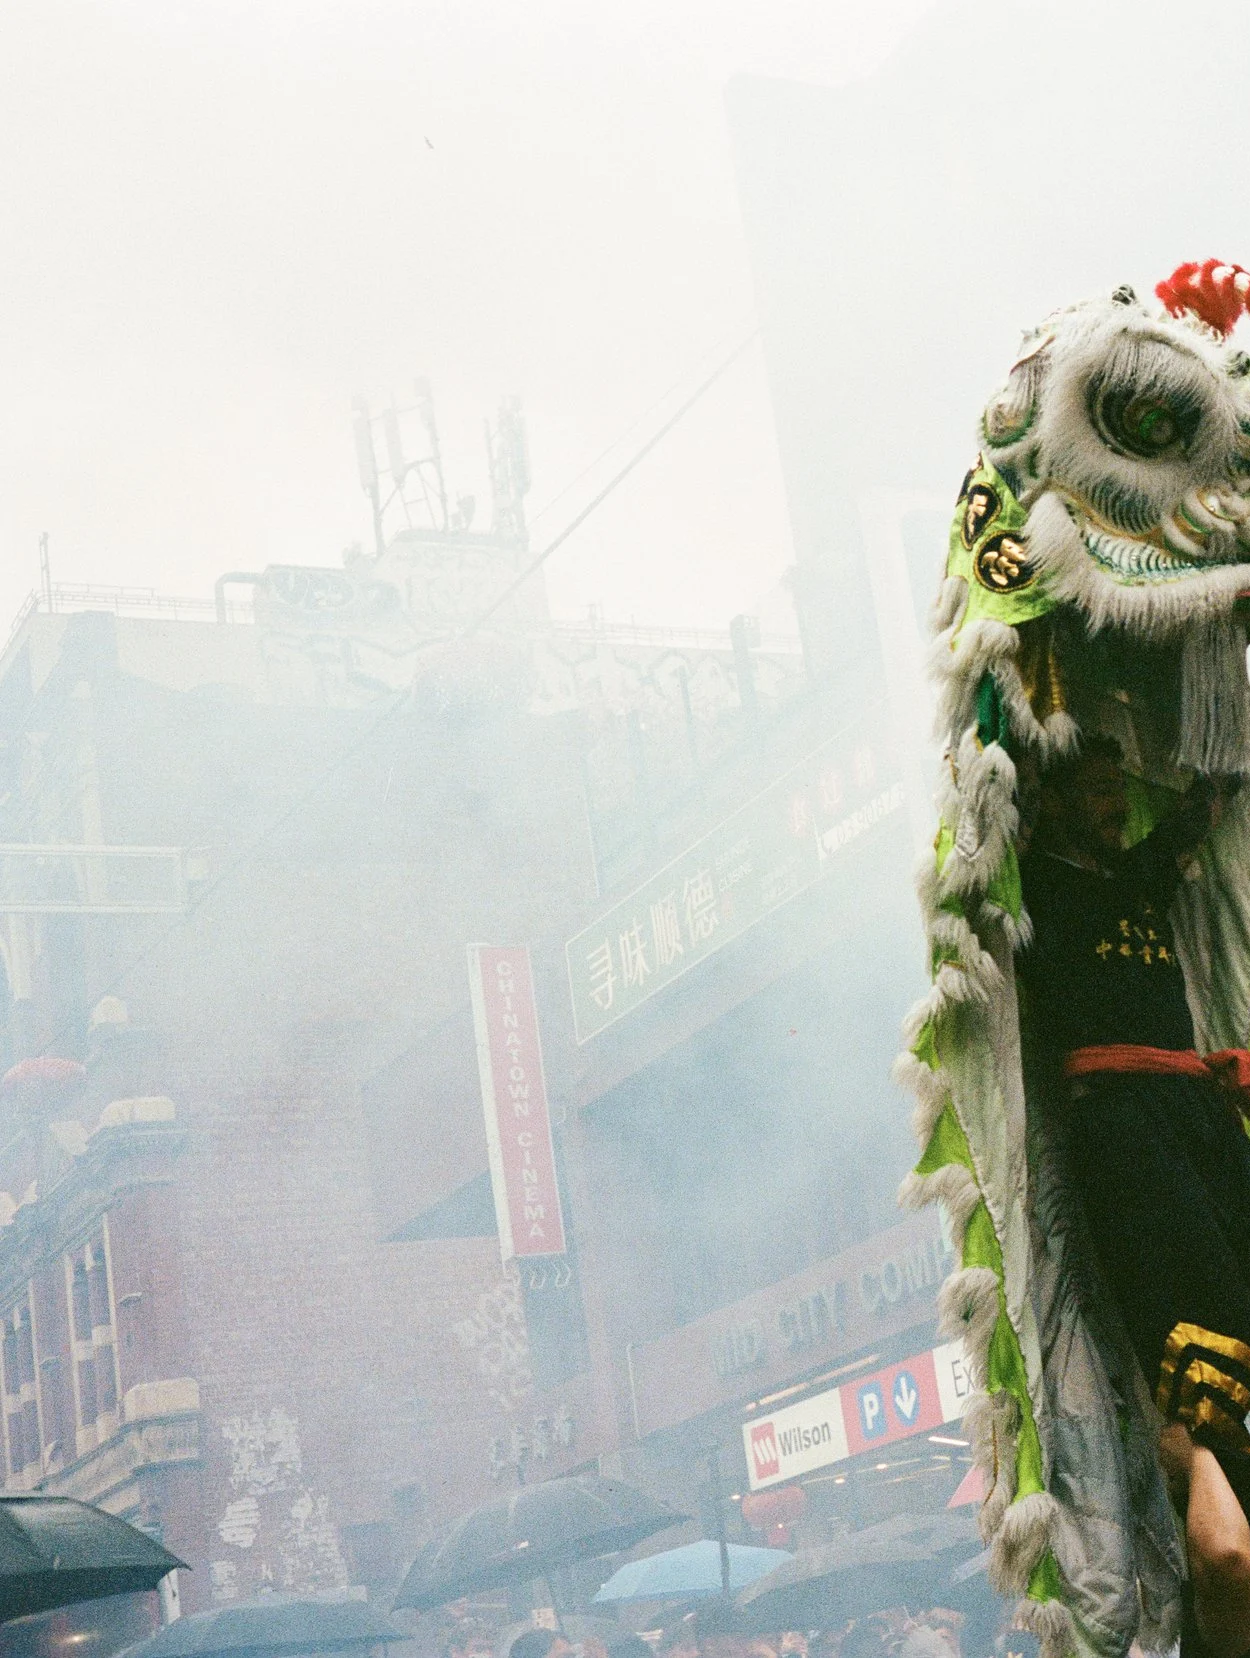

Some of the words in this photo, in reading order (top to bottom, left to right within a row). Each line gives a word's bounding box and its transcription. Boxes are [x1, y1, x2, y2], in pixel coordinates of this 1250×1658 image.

[496, 959, 531, 1119] CHINATOWN
[517, 1130, 546, 1240] CINEMA
[777, 1280, 838, 1347] CITY
[862, 1390, 881, 1431] P
[778, 1421, 831, 1456] Wilson
